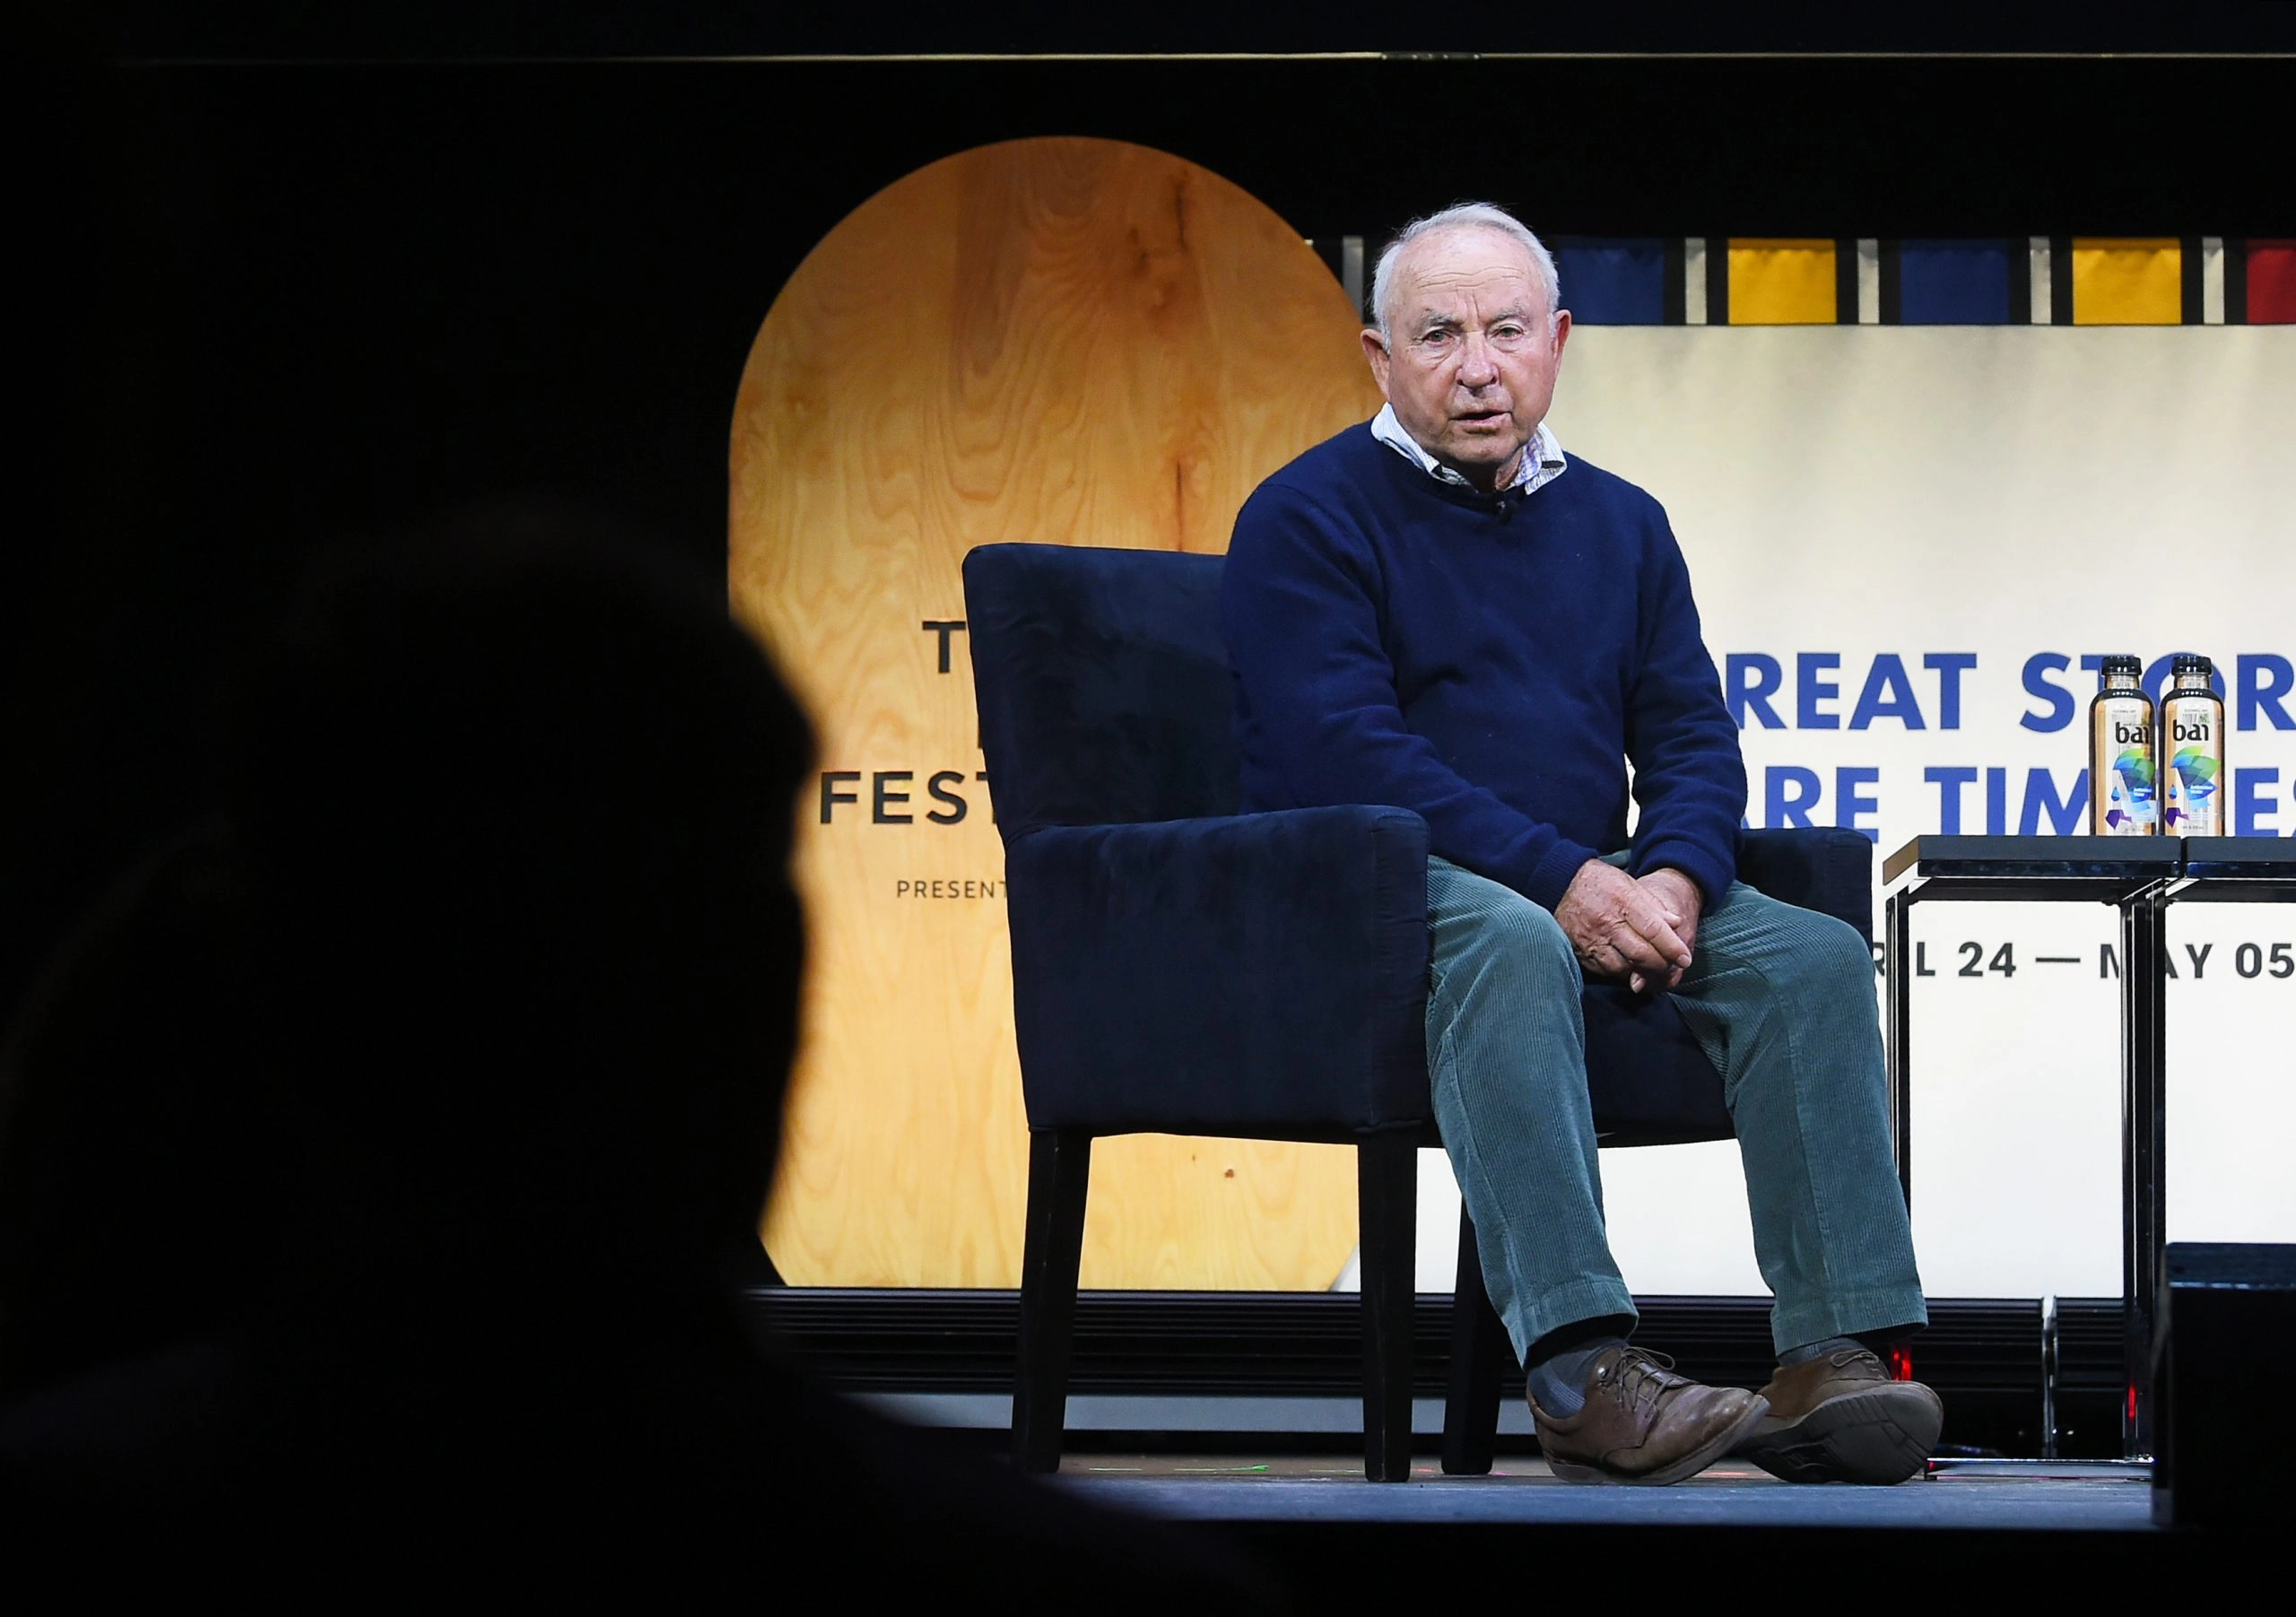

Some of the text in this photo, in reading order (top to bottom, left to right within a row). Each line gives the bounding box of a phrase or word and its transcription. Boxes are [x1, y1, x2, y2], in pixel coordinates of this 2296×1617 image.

[1741, 766, 1880, 844] RE
[1958, 941, 2017, 978] 24
[2234, 942, 2295, 979] 05
